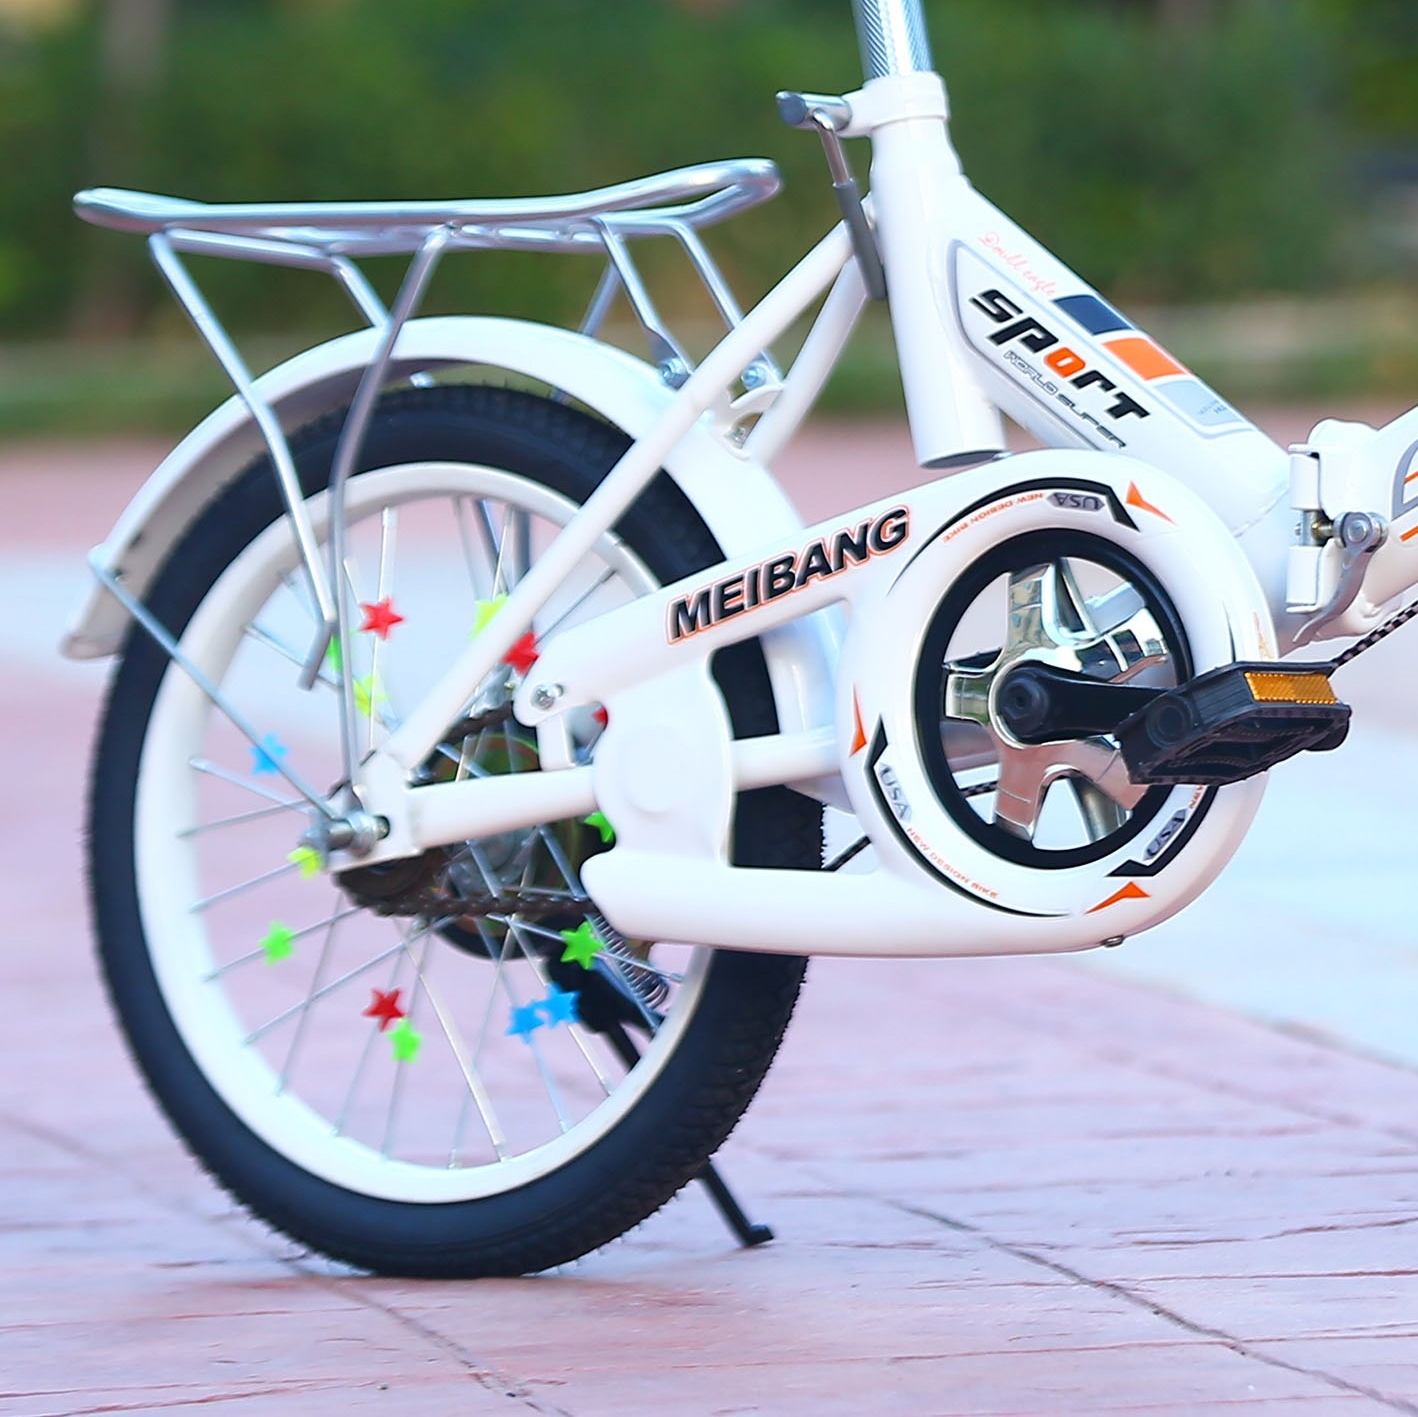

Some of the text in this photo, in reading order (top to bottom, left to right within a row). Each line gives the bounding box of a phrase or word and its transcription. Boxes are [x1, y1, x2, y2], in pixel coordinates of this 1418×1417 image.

[1003, 350, 1126, 448] WORLD SUPER
[667, 507, 909, 641] MEIBANG
[943, 492, 1099, 542] USA NEW DESIGN BIKE
[880, 766, 999, 899] USA NEW DESIGN BIKE
